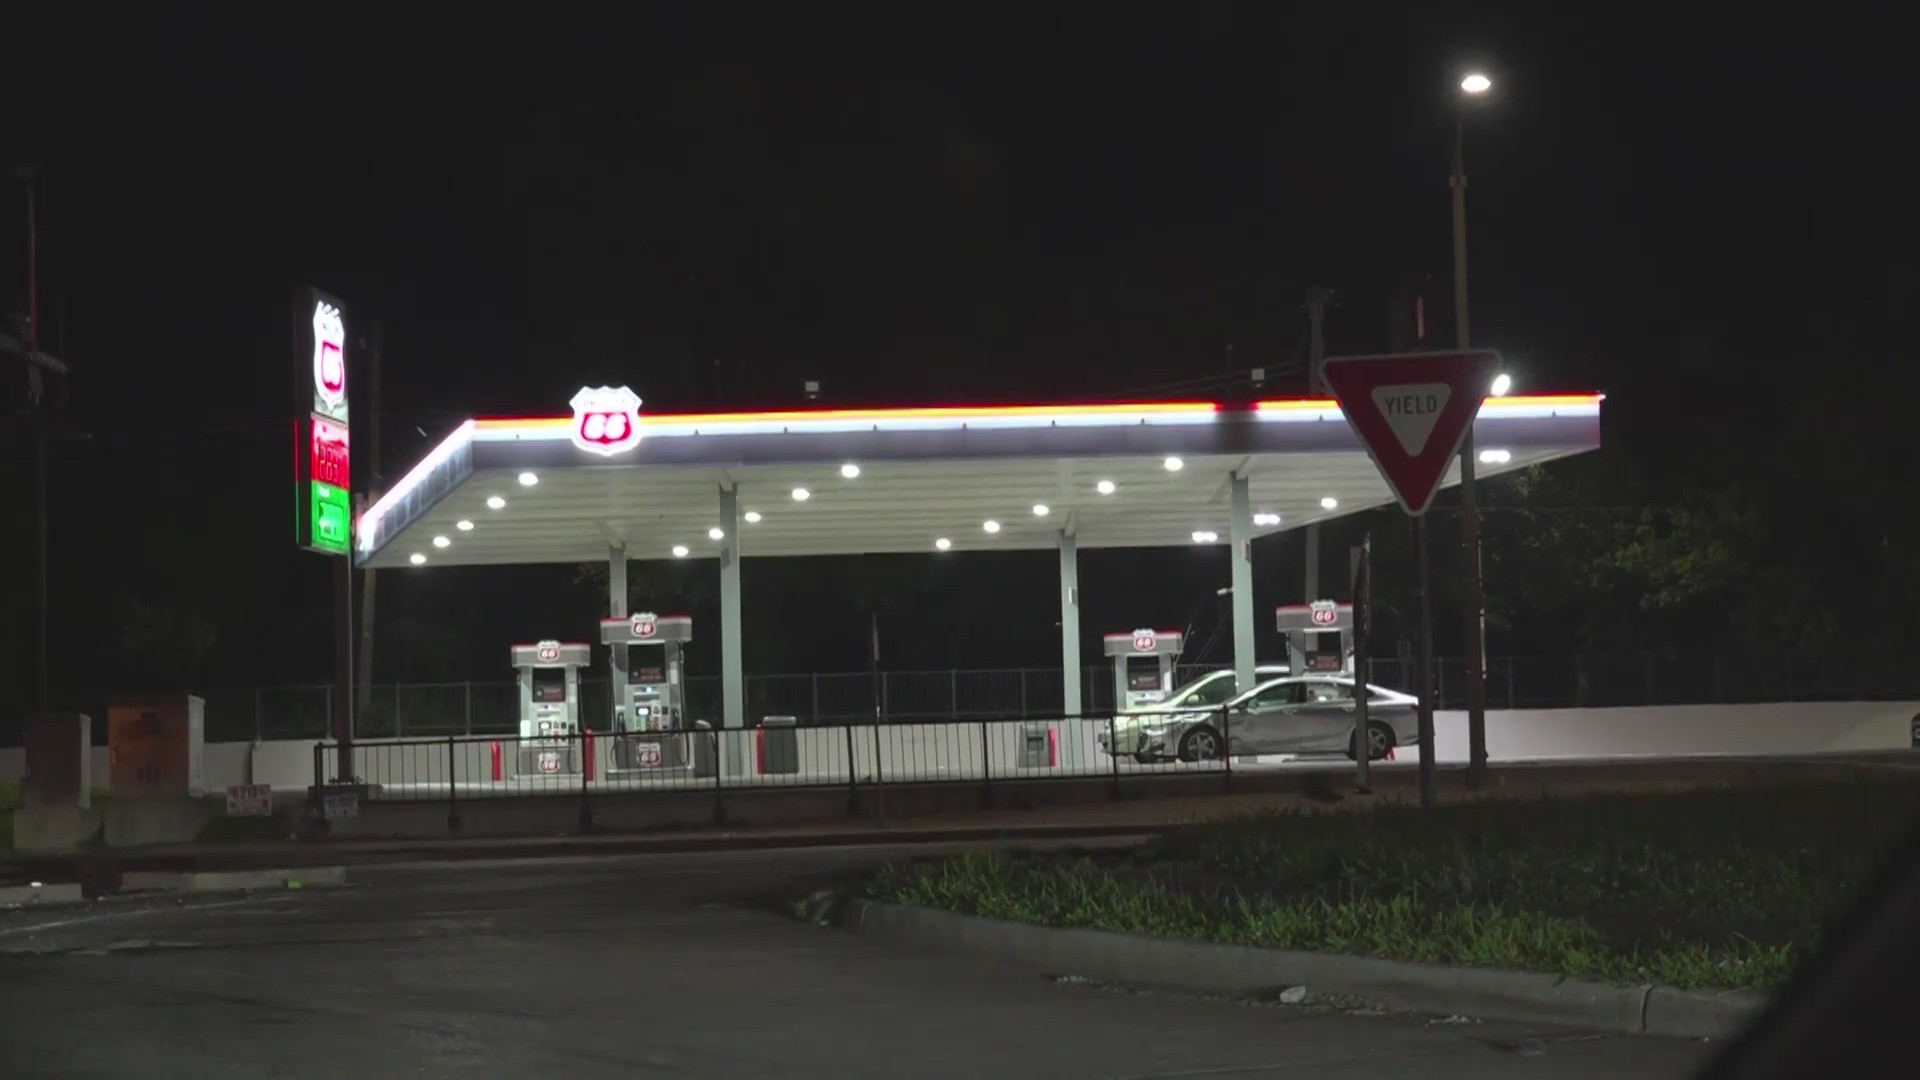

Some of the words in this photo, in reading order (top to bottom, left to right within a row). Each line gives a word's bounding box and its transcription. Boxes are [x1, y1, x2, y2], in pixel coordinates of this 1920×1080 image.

[1385, 395, 1437, 415] YIELD
[584, 413, 626, 440] 66
[1315, 610, 1331, 621] 66
[635, 623, 651, 634] 66
[1137, 638, 1151, 647] 66
[541, 650, 555, 658] 66
